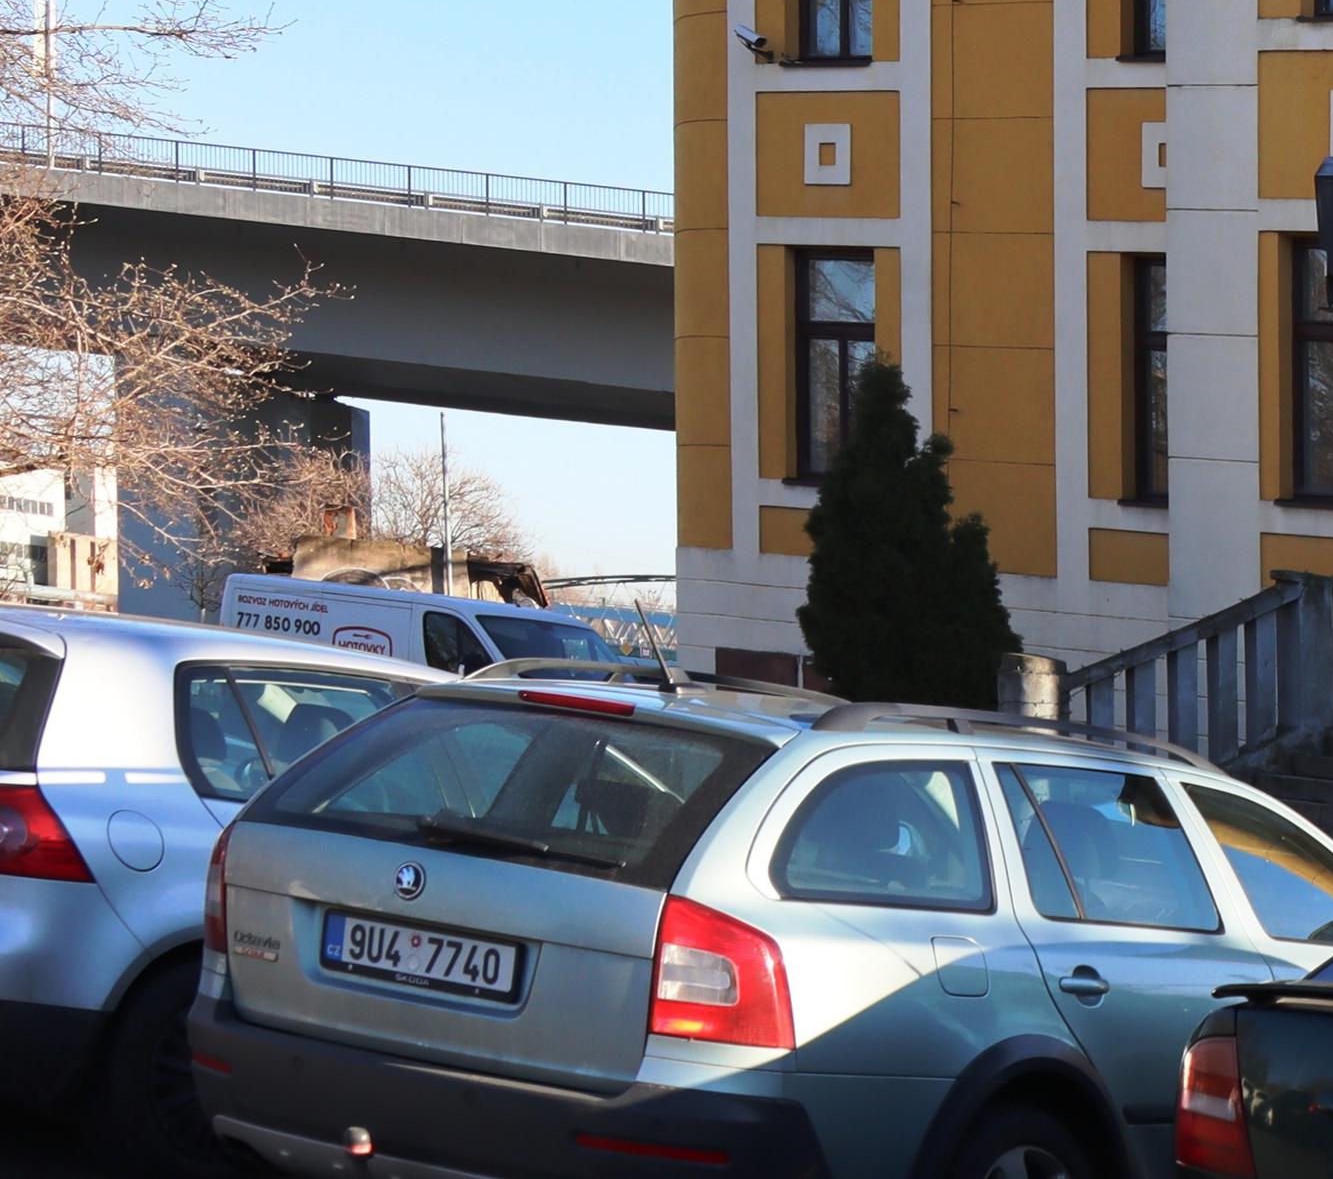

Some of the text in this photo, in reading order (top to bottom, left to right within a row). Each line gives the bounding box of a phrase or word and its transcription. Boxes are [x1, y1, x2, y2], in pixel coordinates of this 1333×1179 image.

[237, 594, 329, 614] ROZVOZ HOTOVÝCH JÍDEL
[236, 612, 321, 636] 777 850 900
[327, 924, 501, 986] CZ 9U4 7740
